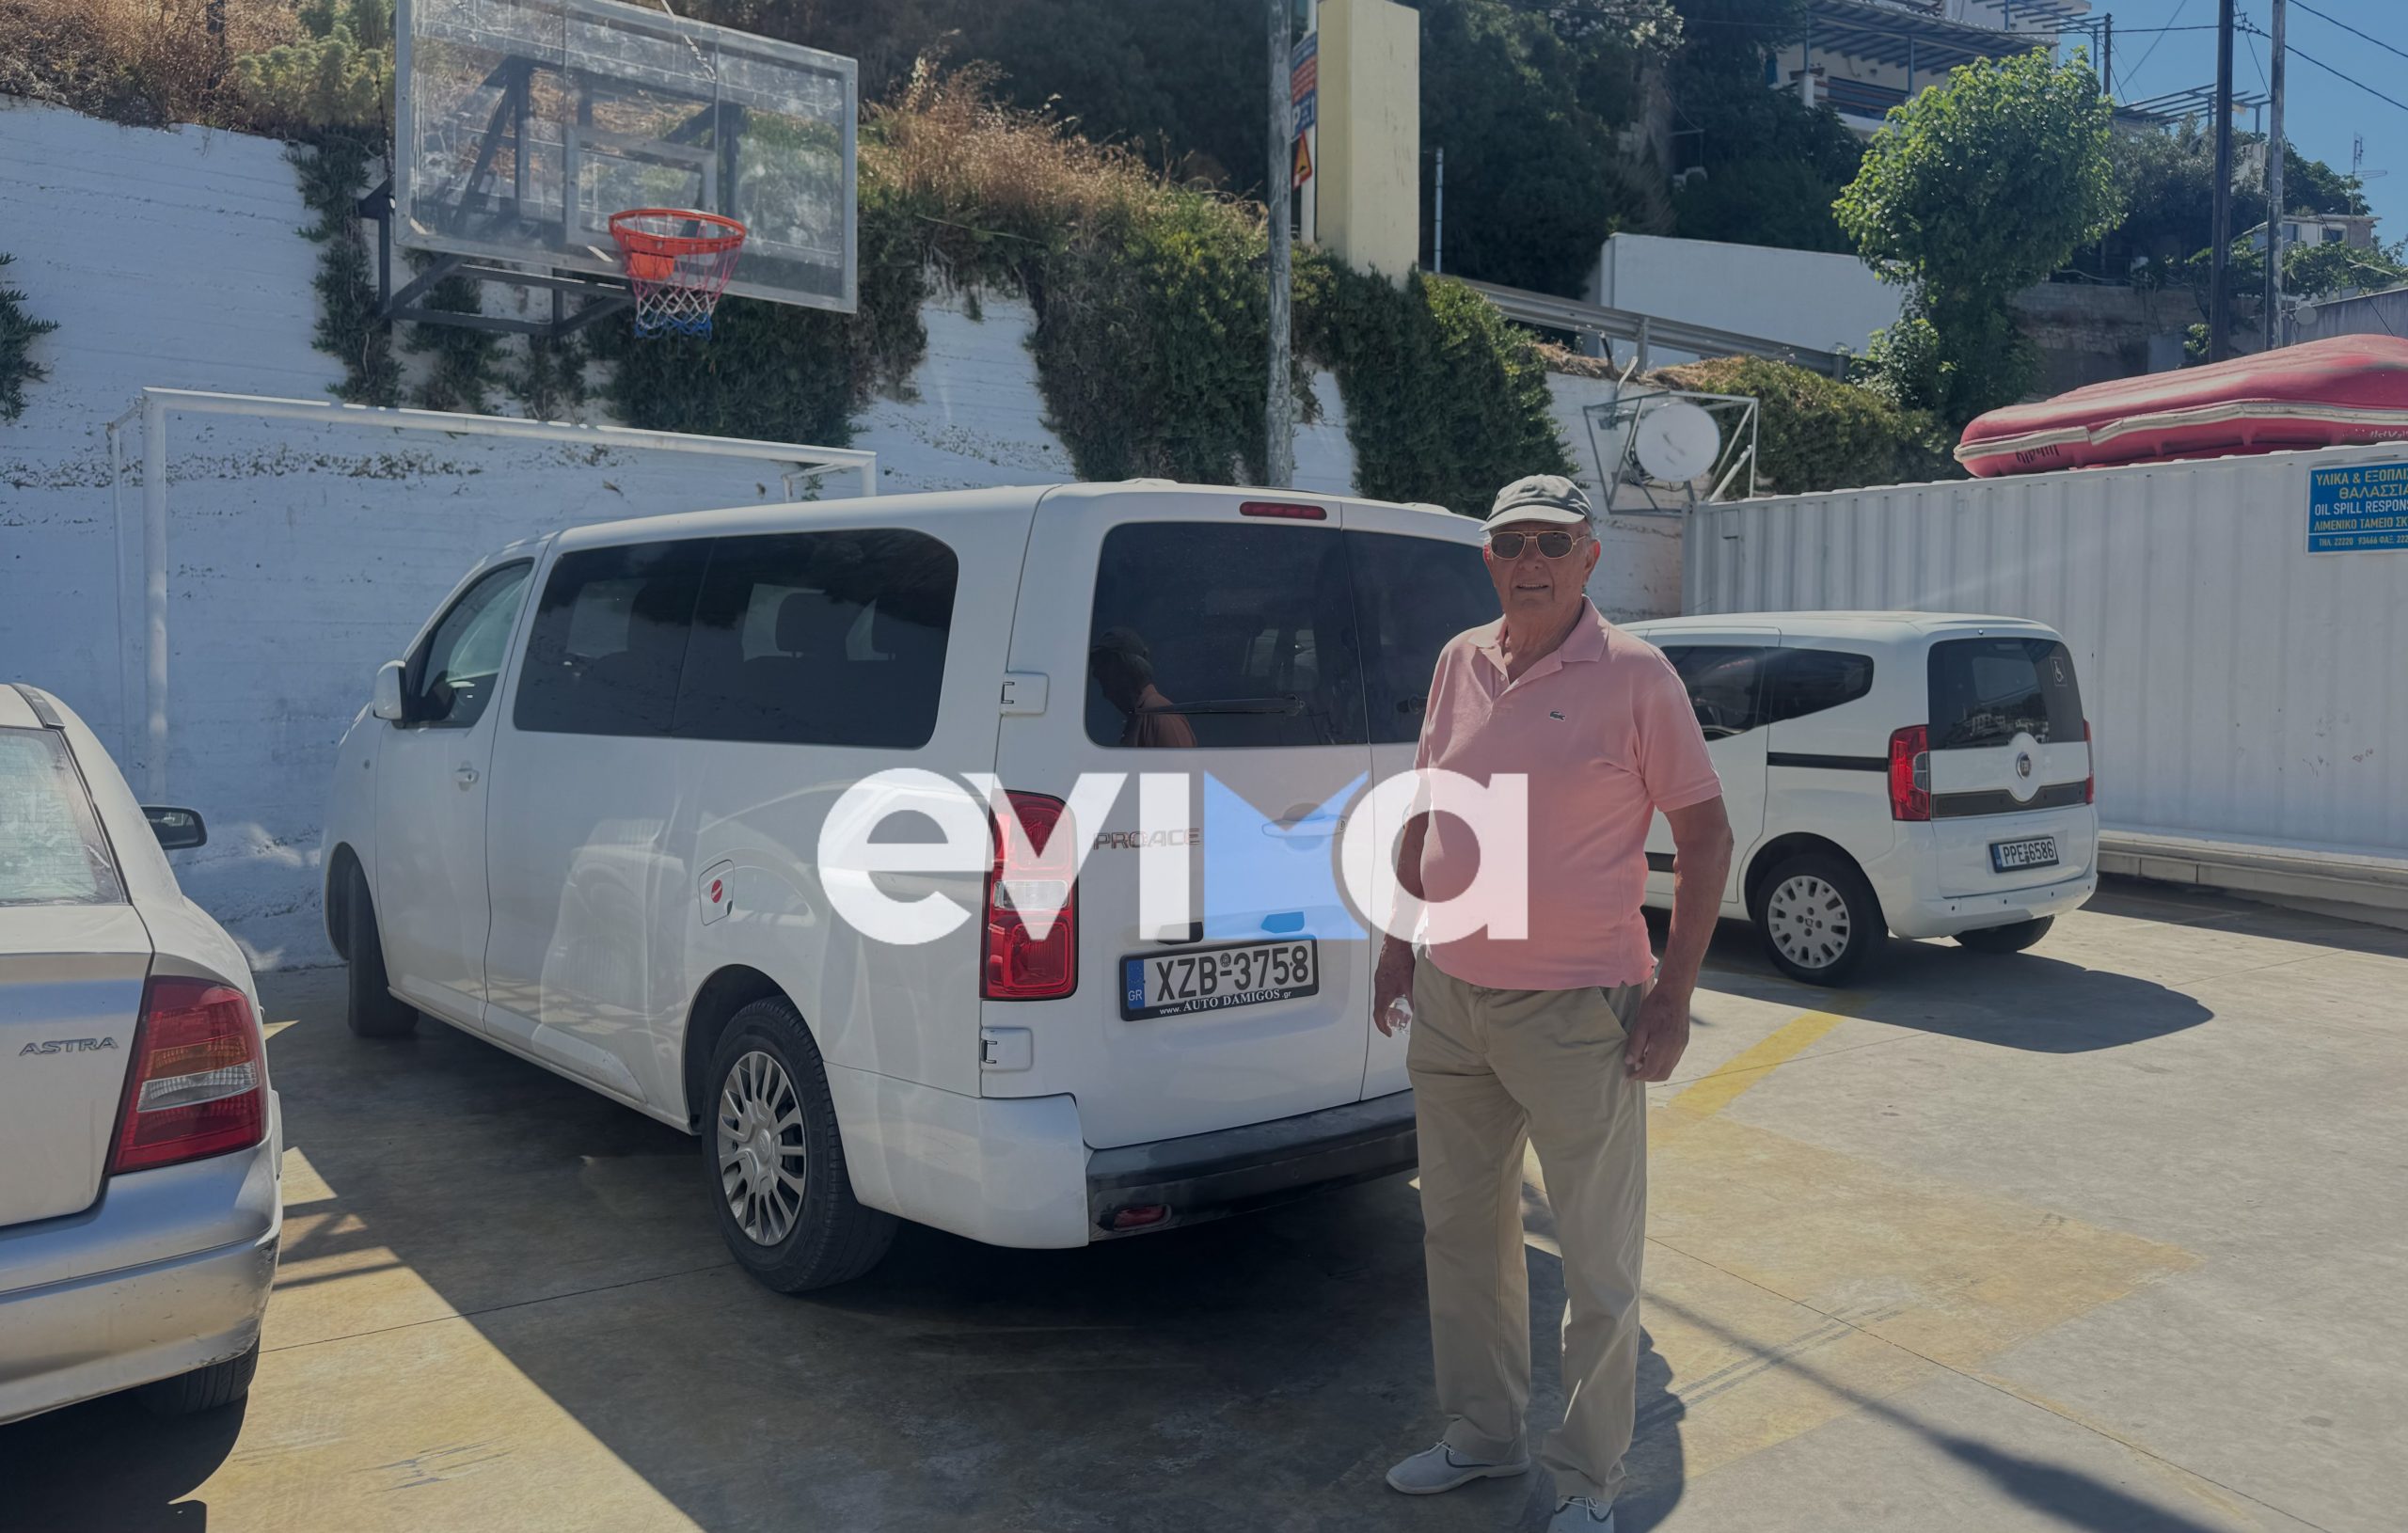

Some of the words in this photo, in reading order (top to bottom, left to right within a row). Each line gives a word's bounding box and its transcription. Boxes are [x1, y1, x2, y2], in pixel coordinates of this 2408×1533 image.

[2316, 472, 2350, 486] ΥΛΙΚΑ
[2353, 473, 2361, 483] &
[2365, 468, 2408, 482] ΕΞΟΠΛΙ
[2314, 504, 2331, 516] OIL
[2333, 501, 2362, 514] SPILL
[2366, 499, 2408, 513] RESPON
[2314, 519, 2357, 531] ΛΙΜΕΝΙΚΟ
[2360, 517, 2393, 529] ΤΑΜΕΙΟ
[1093, 828, 1201, 850] PROACE
[1128, 988, 1144, 1002] GR
[1183, 996, 1219, 1012] AUTO
[1223, 988, 1281, 1006] DAMIGOS
[19, 1036, 119, 1056] ASTRA
